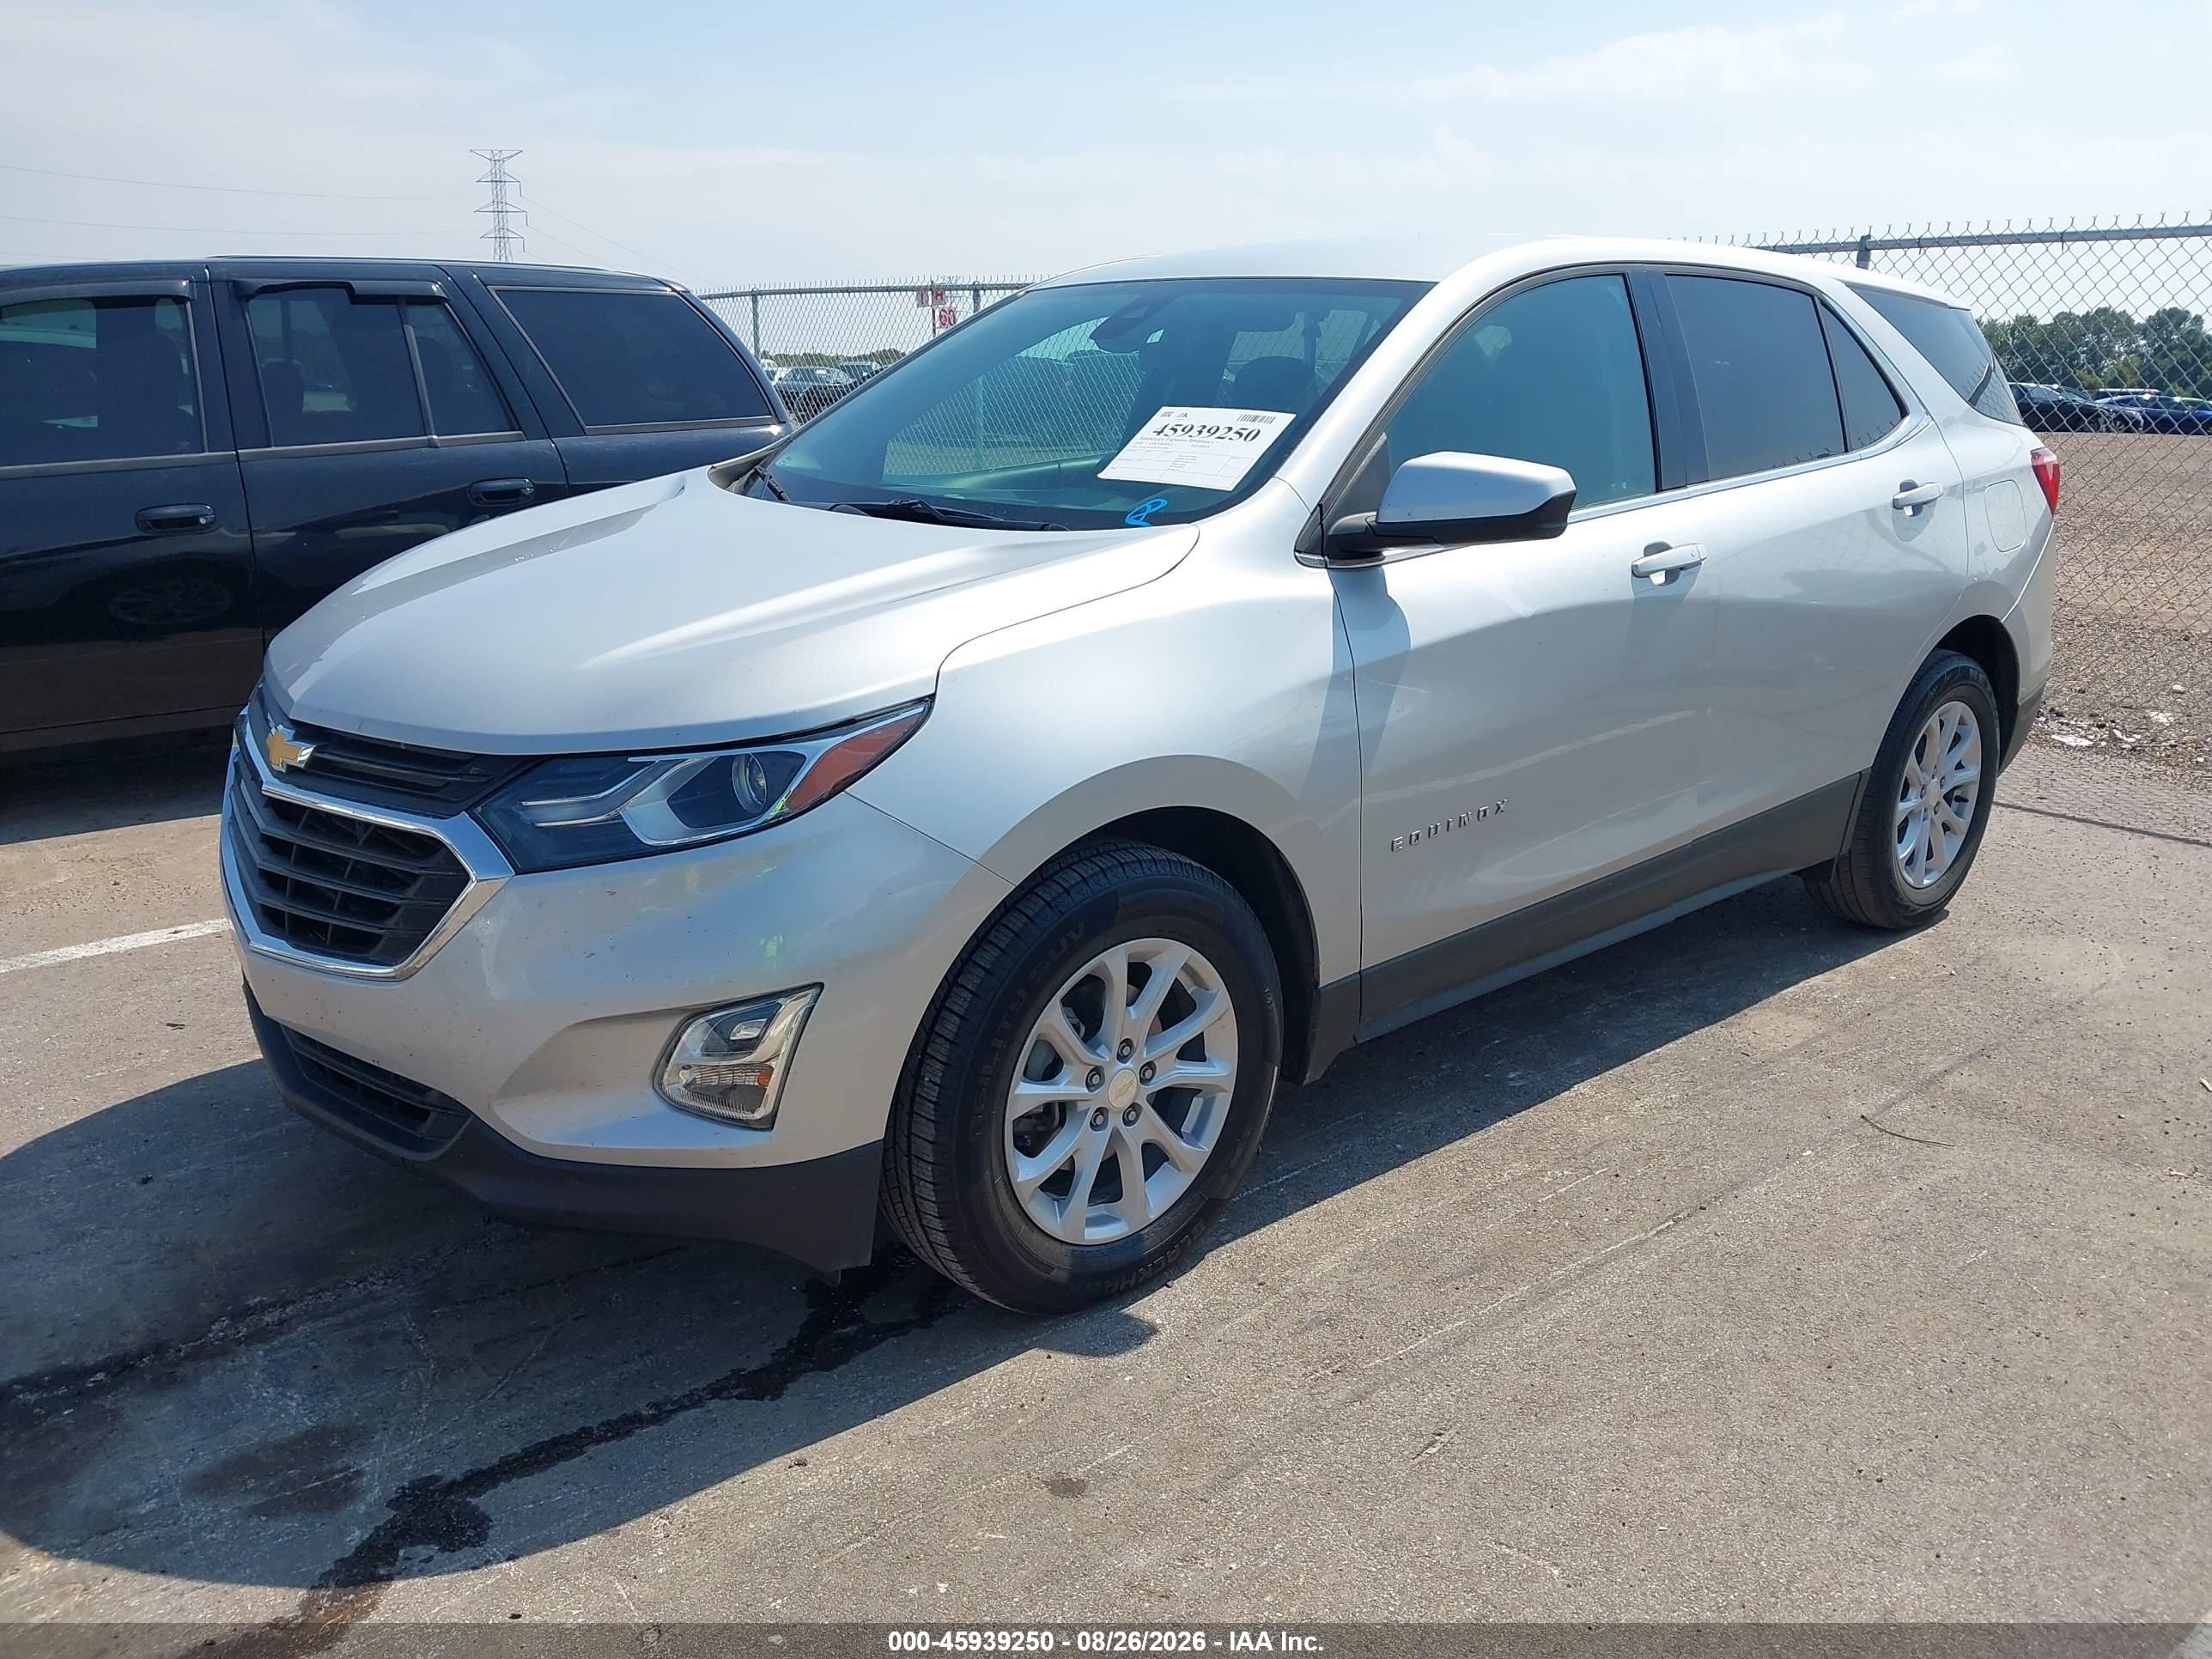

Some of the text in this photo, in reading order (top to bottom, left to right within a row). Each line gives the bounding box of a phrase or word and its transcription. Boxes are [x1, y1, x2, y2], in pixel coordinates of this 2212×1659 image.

[1152, 423, 1261, 442] 45939250
[1390, 799, 1508, 852] EQUINOX
[1028, 919, 1087, 985] SUV
[1066, 1218, 1207, 1297] BLACKHA
